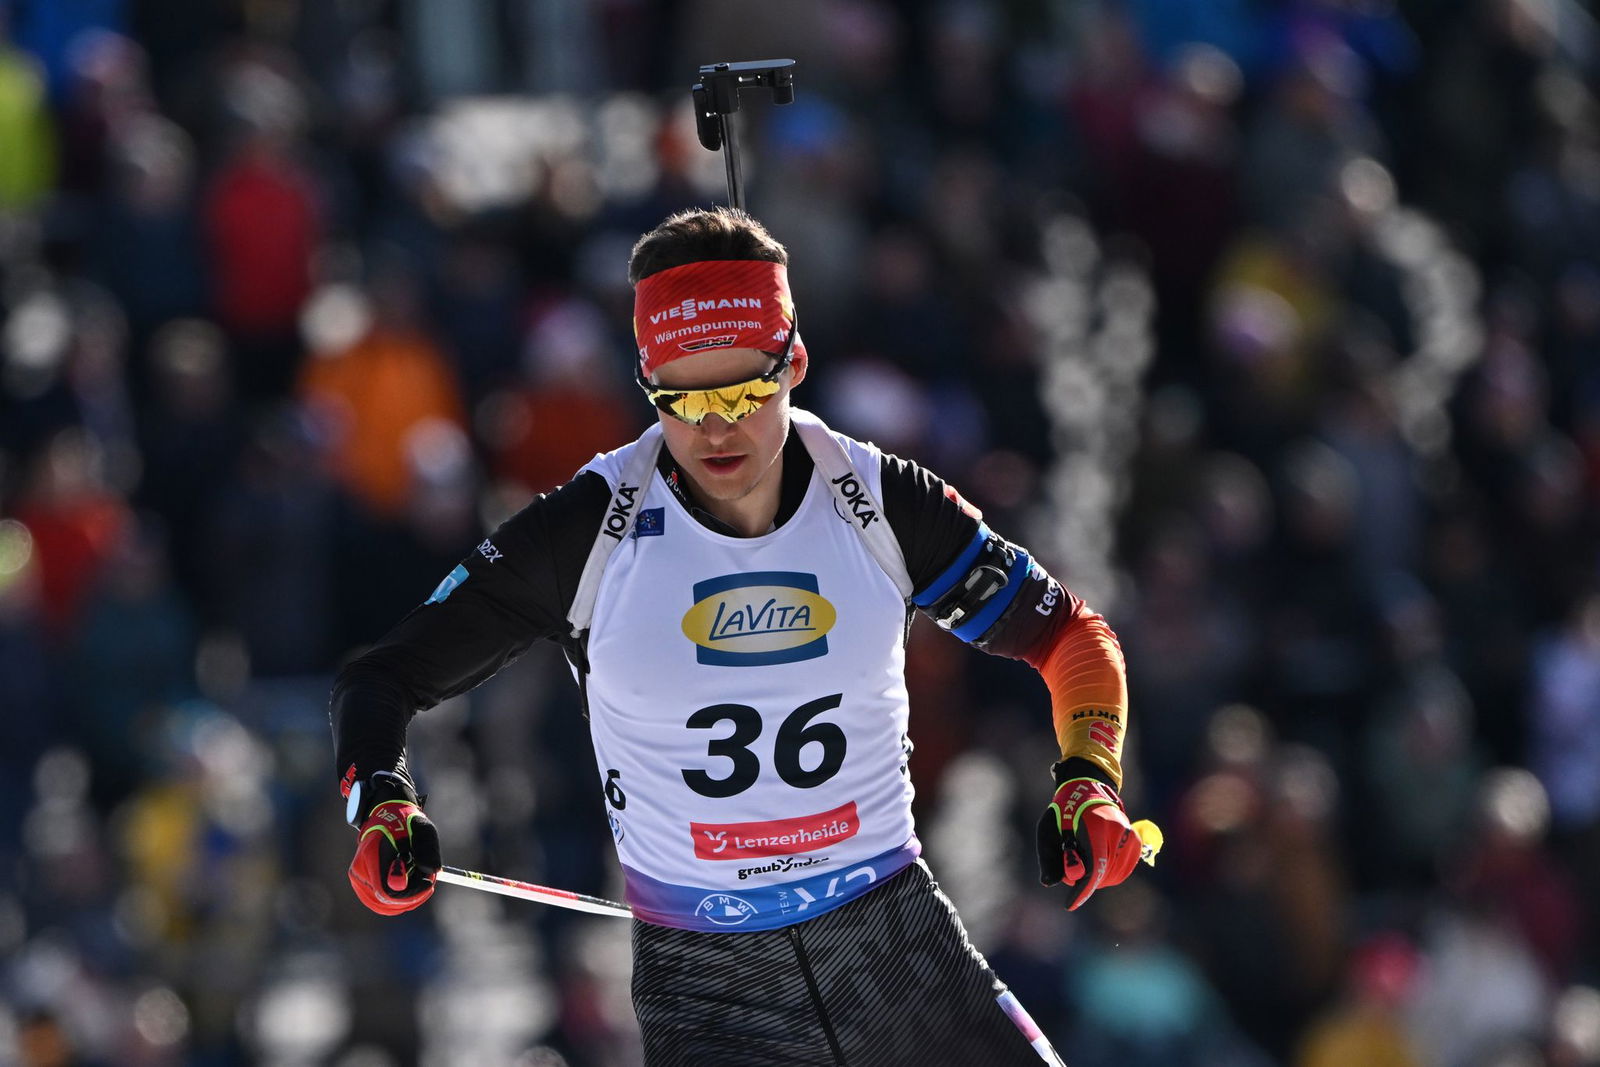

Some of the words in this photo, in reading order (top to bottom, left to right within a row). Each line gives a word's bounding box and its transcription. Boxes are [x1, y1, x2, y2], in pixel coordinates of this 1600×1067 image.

[650, 298, 762, 324] VIESSMANN
[655, 320, 762, 345] Wärmepumpen
[603, 485, 639, 541] JOKA
[832, 472, 877, 529] JOKA
[681, 693, 847, 798] 36
[604, 768, 626, 811] 6
[1063, 784, 1089, 820] LEKI
[376, 808, 405, 832] LEKI
[735, 820, 849, 849] Lenzerheide
